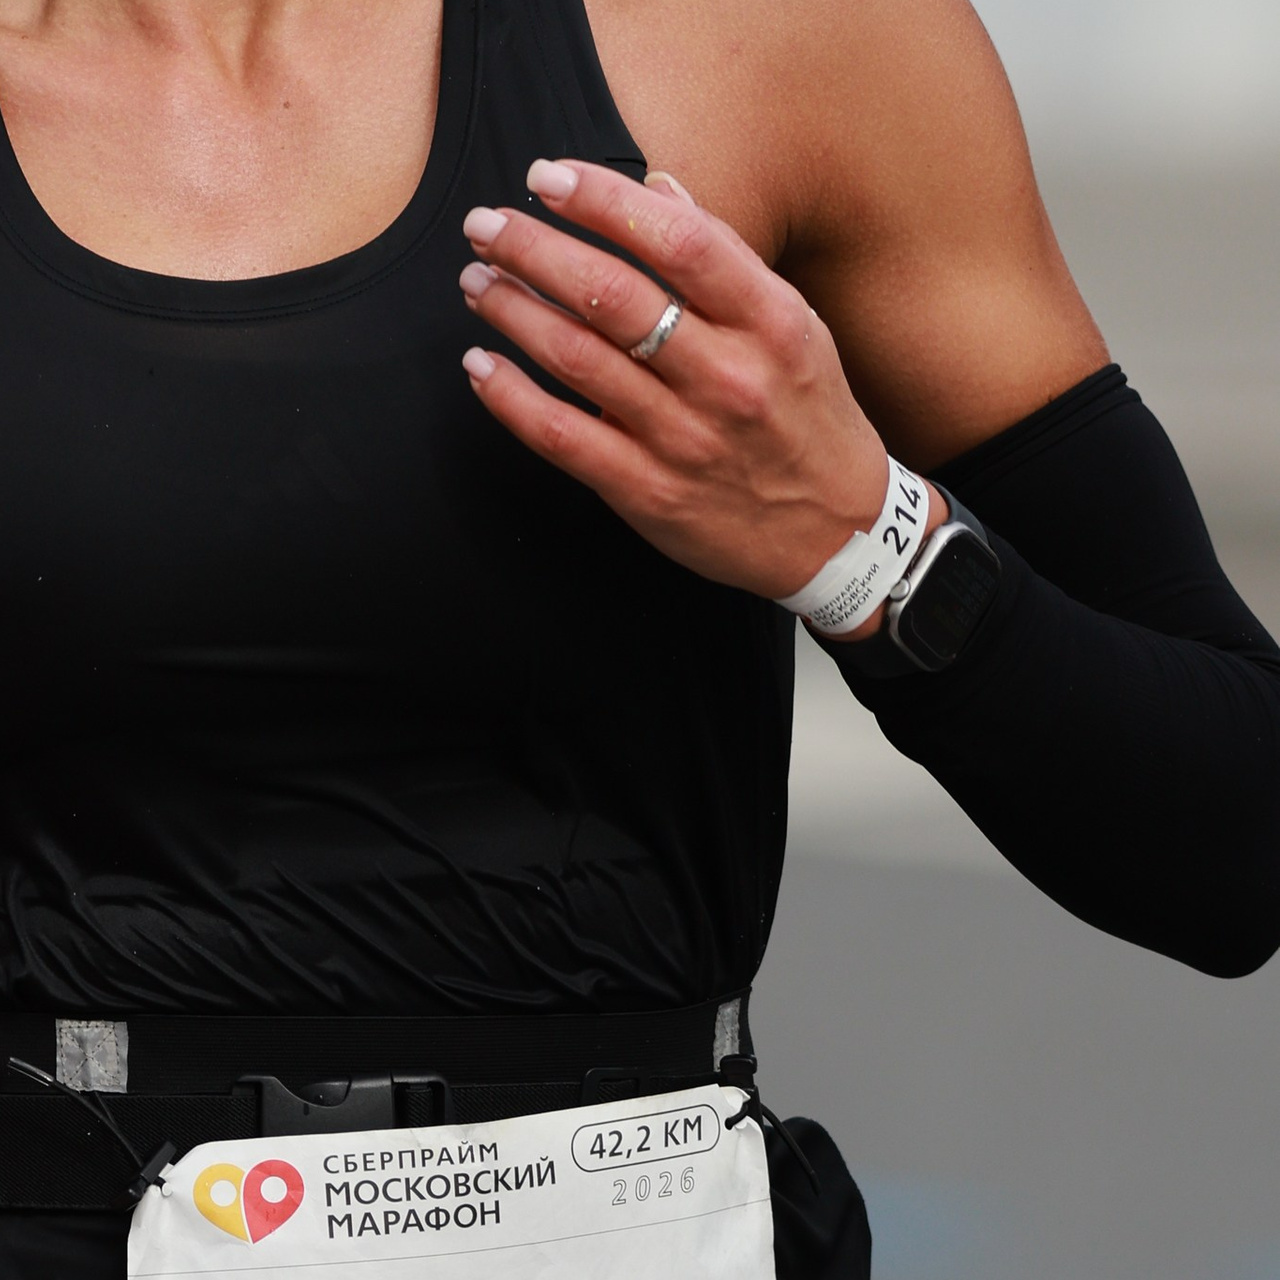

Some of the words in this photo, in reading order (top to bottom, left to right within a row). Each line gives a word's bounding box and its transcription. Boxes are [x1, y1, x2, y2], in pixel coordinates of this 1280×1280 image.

[883, 465, 921, 556] 2141
[323, 1140, 499, 1174] СБЕРПРАЙМ
[590, 1125, 651, 1159] 42,2
[664, 1115, 702, 1148] КМ
[325, 1155, 557, 1208] МОСКОВСКИЙ
[612, 1166, 695, 1206] 2026
[327, 1200, 501, 1239] МАРАФОН
